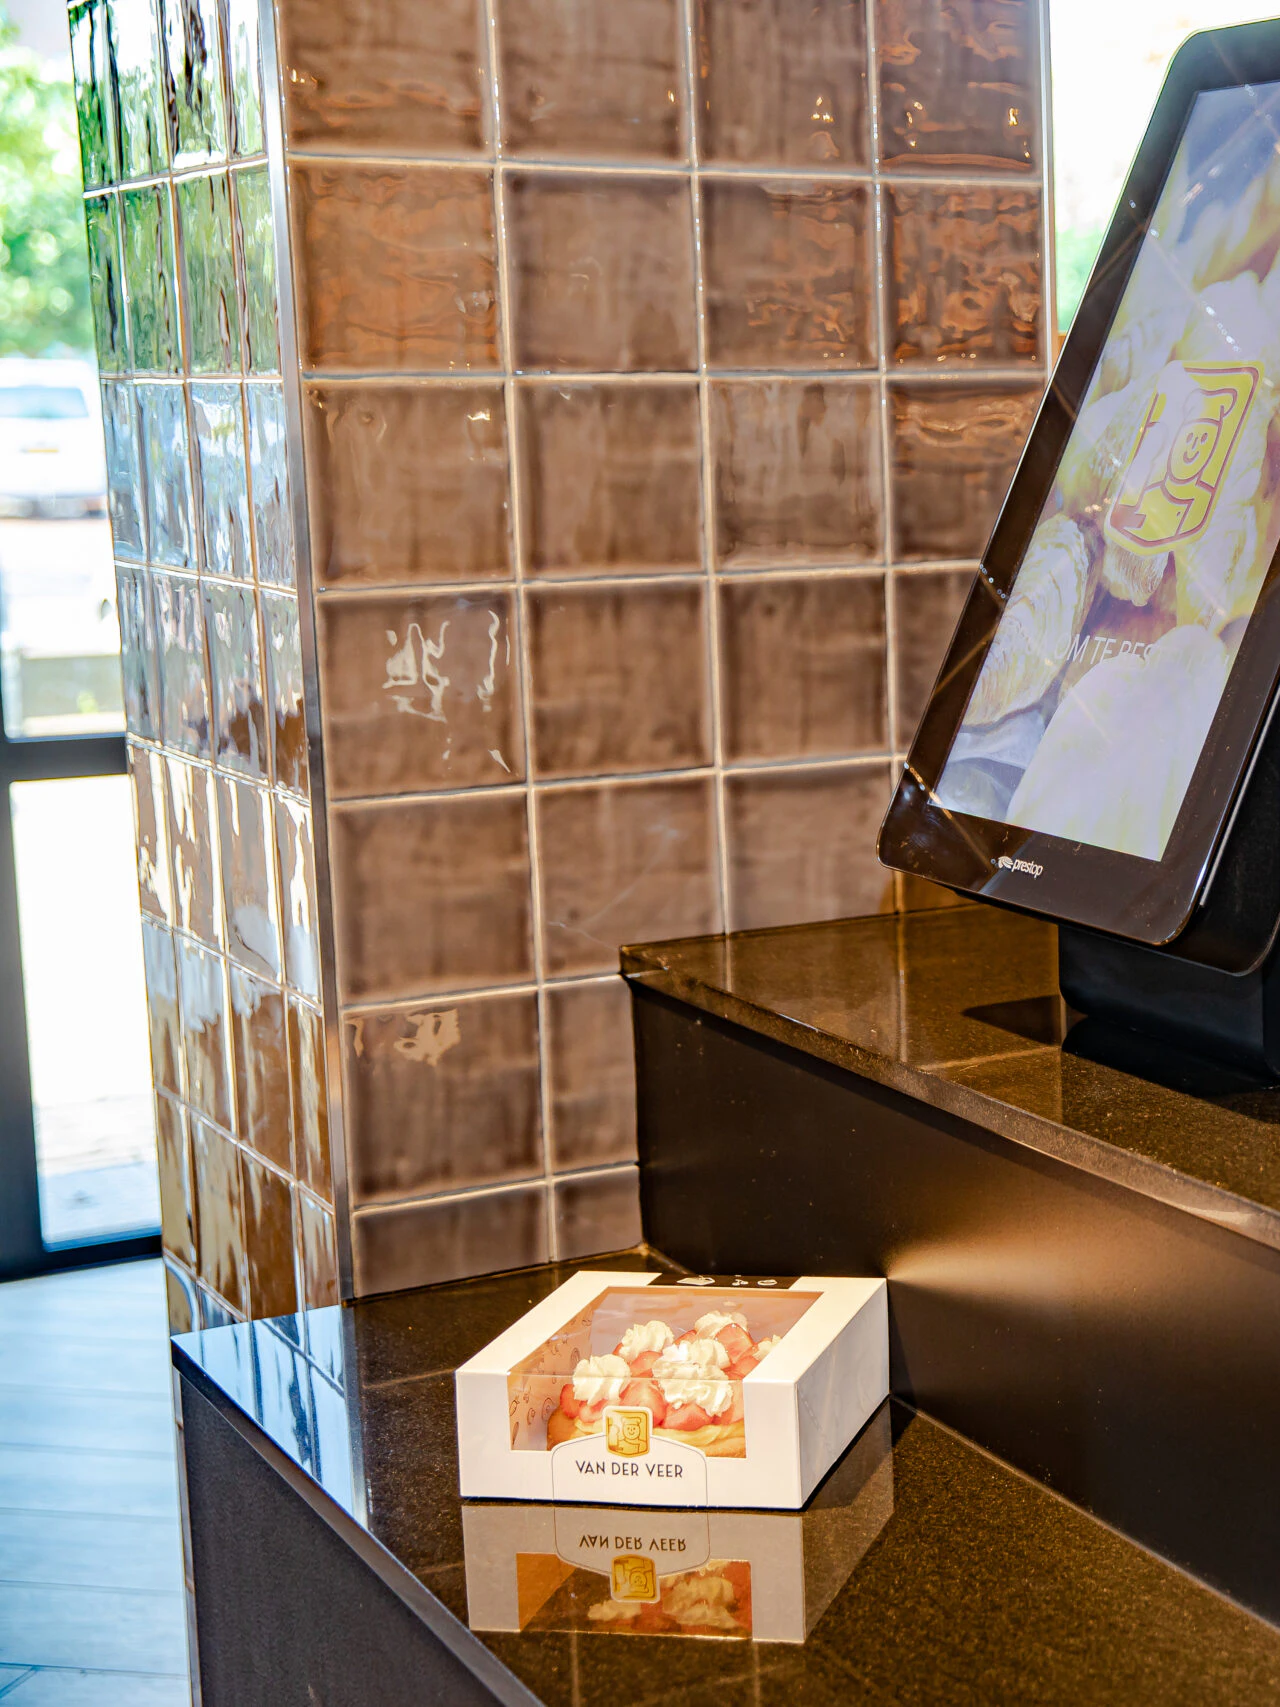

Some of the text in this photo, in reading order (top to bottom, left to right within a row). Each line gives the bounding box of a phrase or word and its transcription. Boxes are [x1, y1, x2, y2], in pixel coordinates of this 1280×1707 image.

[1011, 858, 1043, 878] prestop
[576, 1460, 683, 1478] VAN DER VEER
